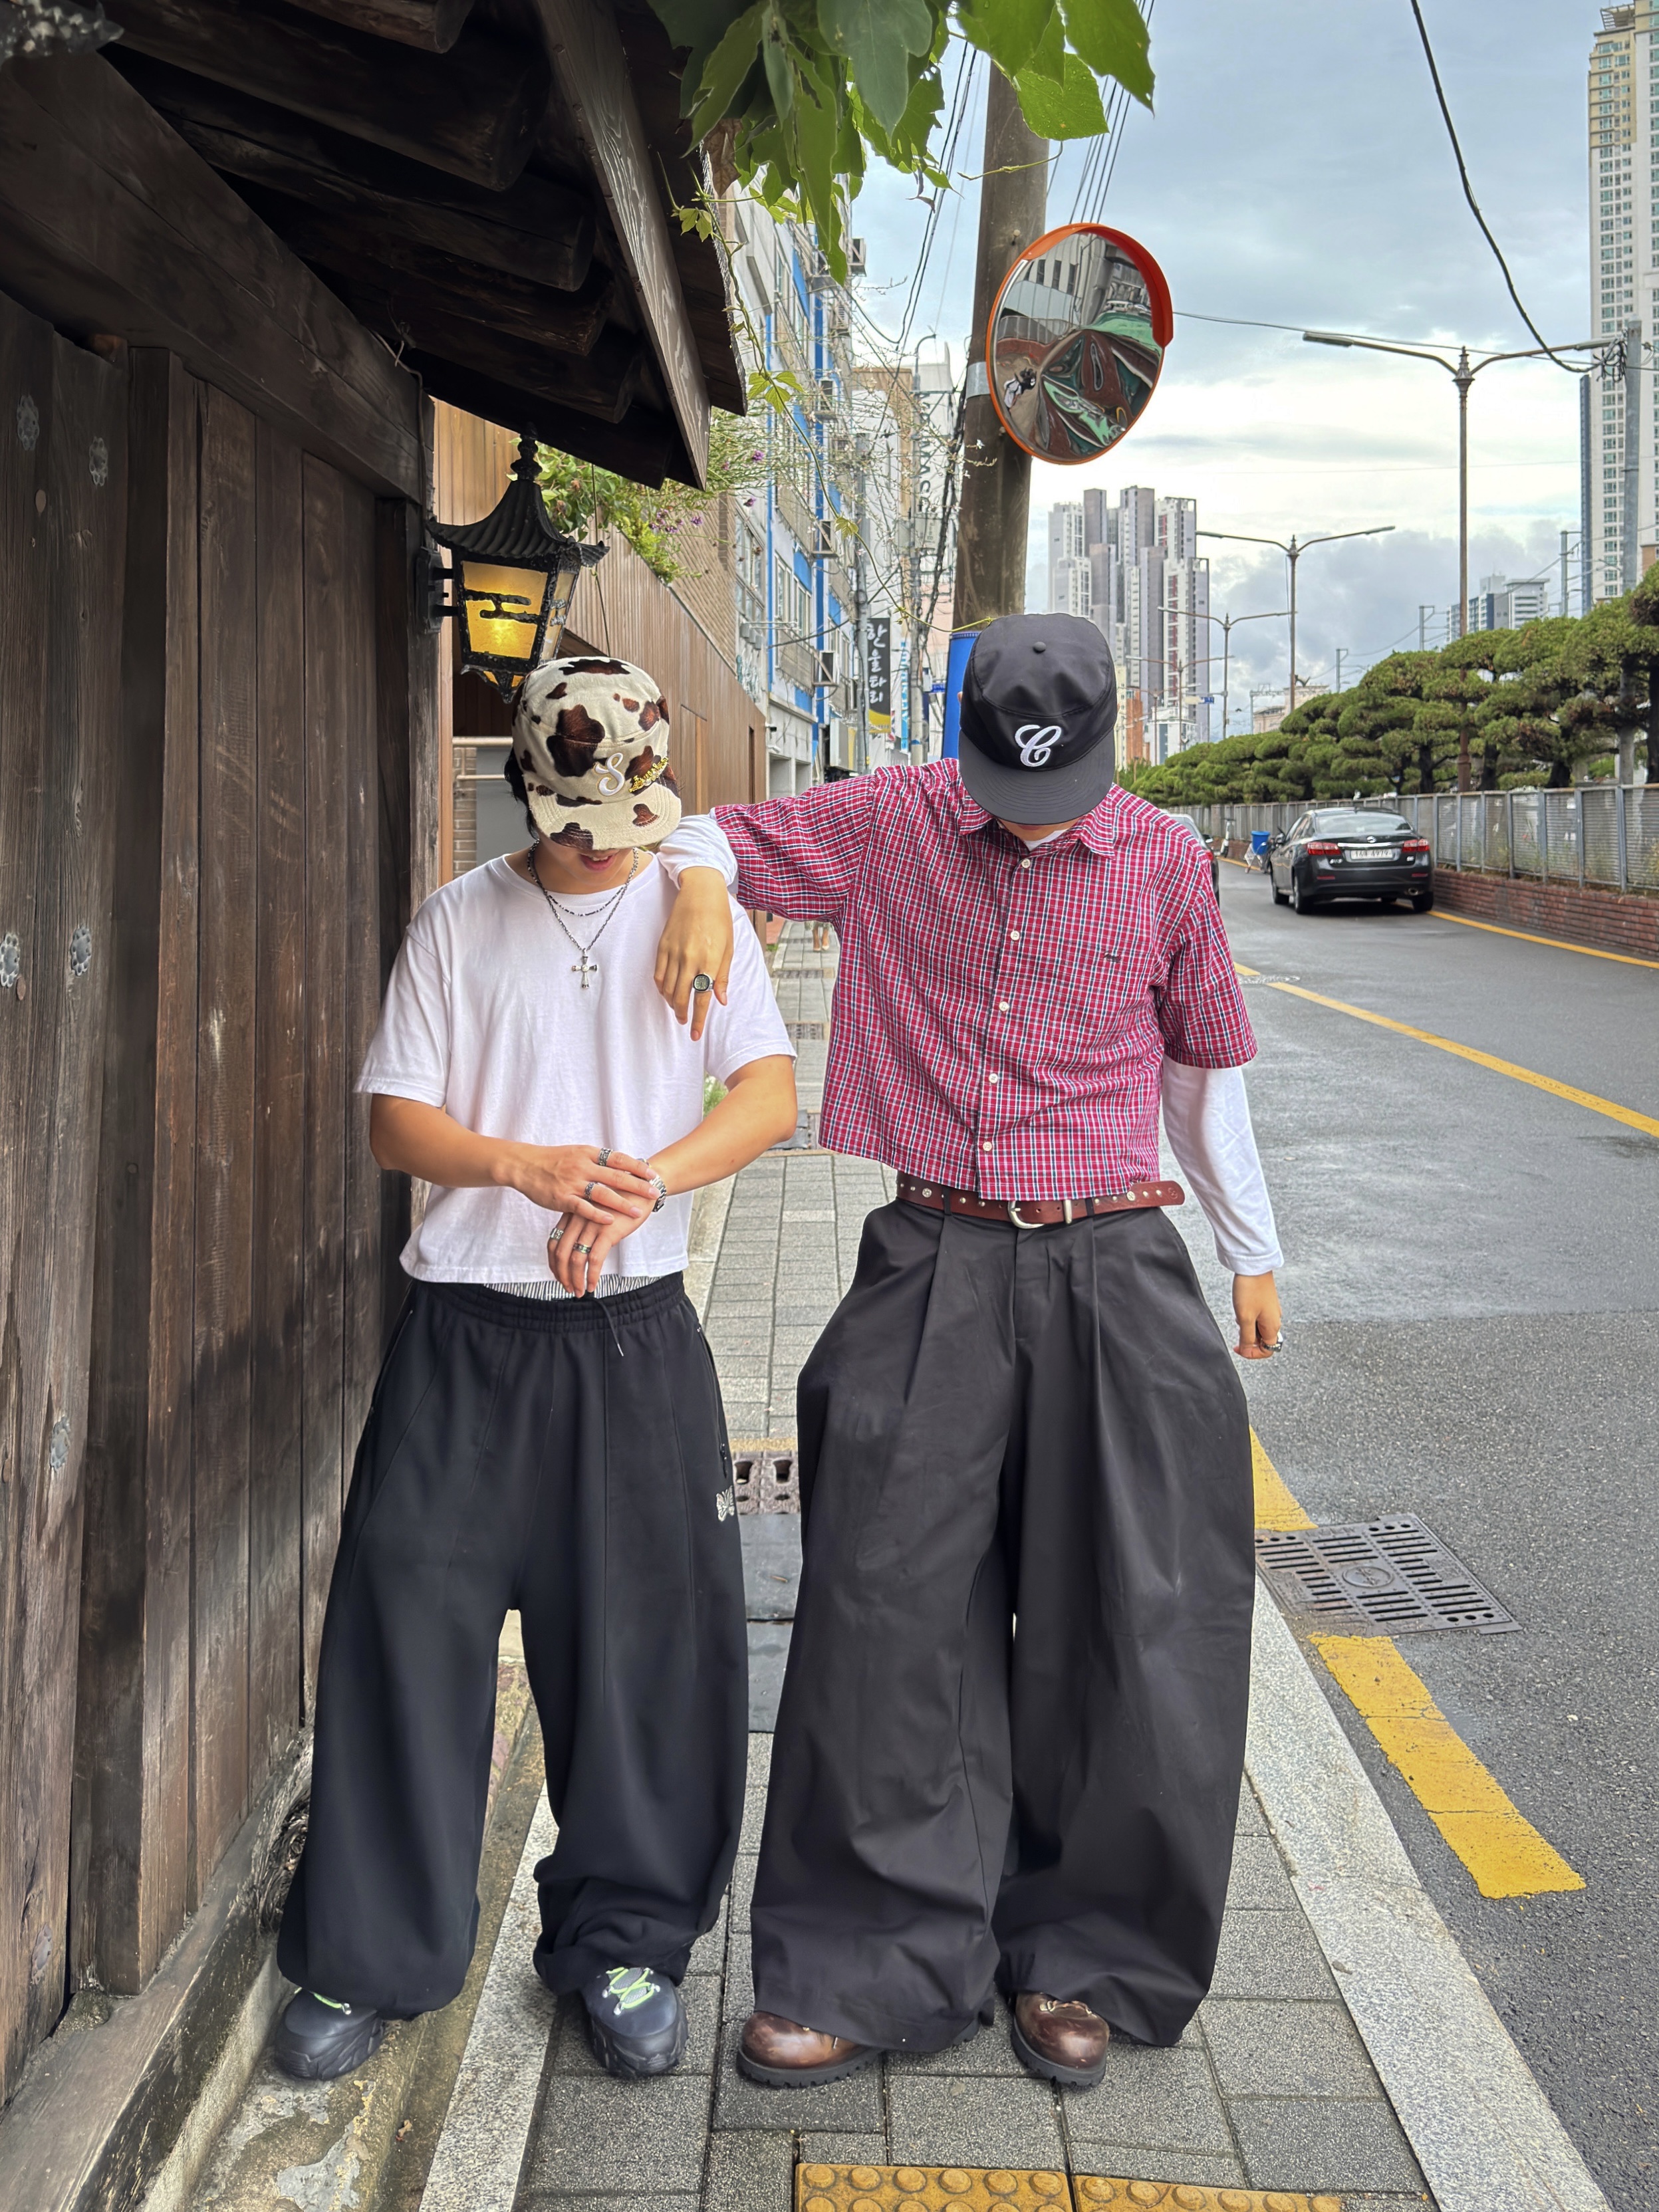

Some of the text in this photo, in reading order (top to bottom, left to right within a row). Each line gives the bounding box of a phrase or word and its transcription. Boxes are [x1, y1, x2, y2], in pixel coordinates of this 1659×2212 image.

[867, 622, 888, 704] 한울타리
[1015, 724, 1062, 767] C
[594, 752, 625, 797] S
